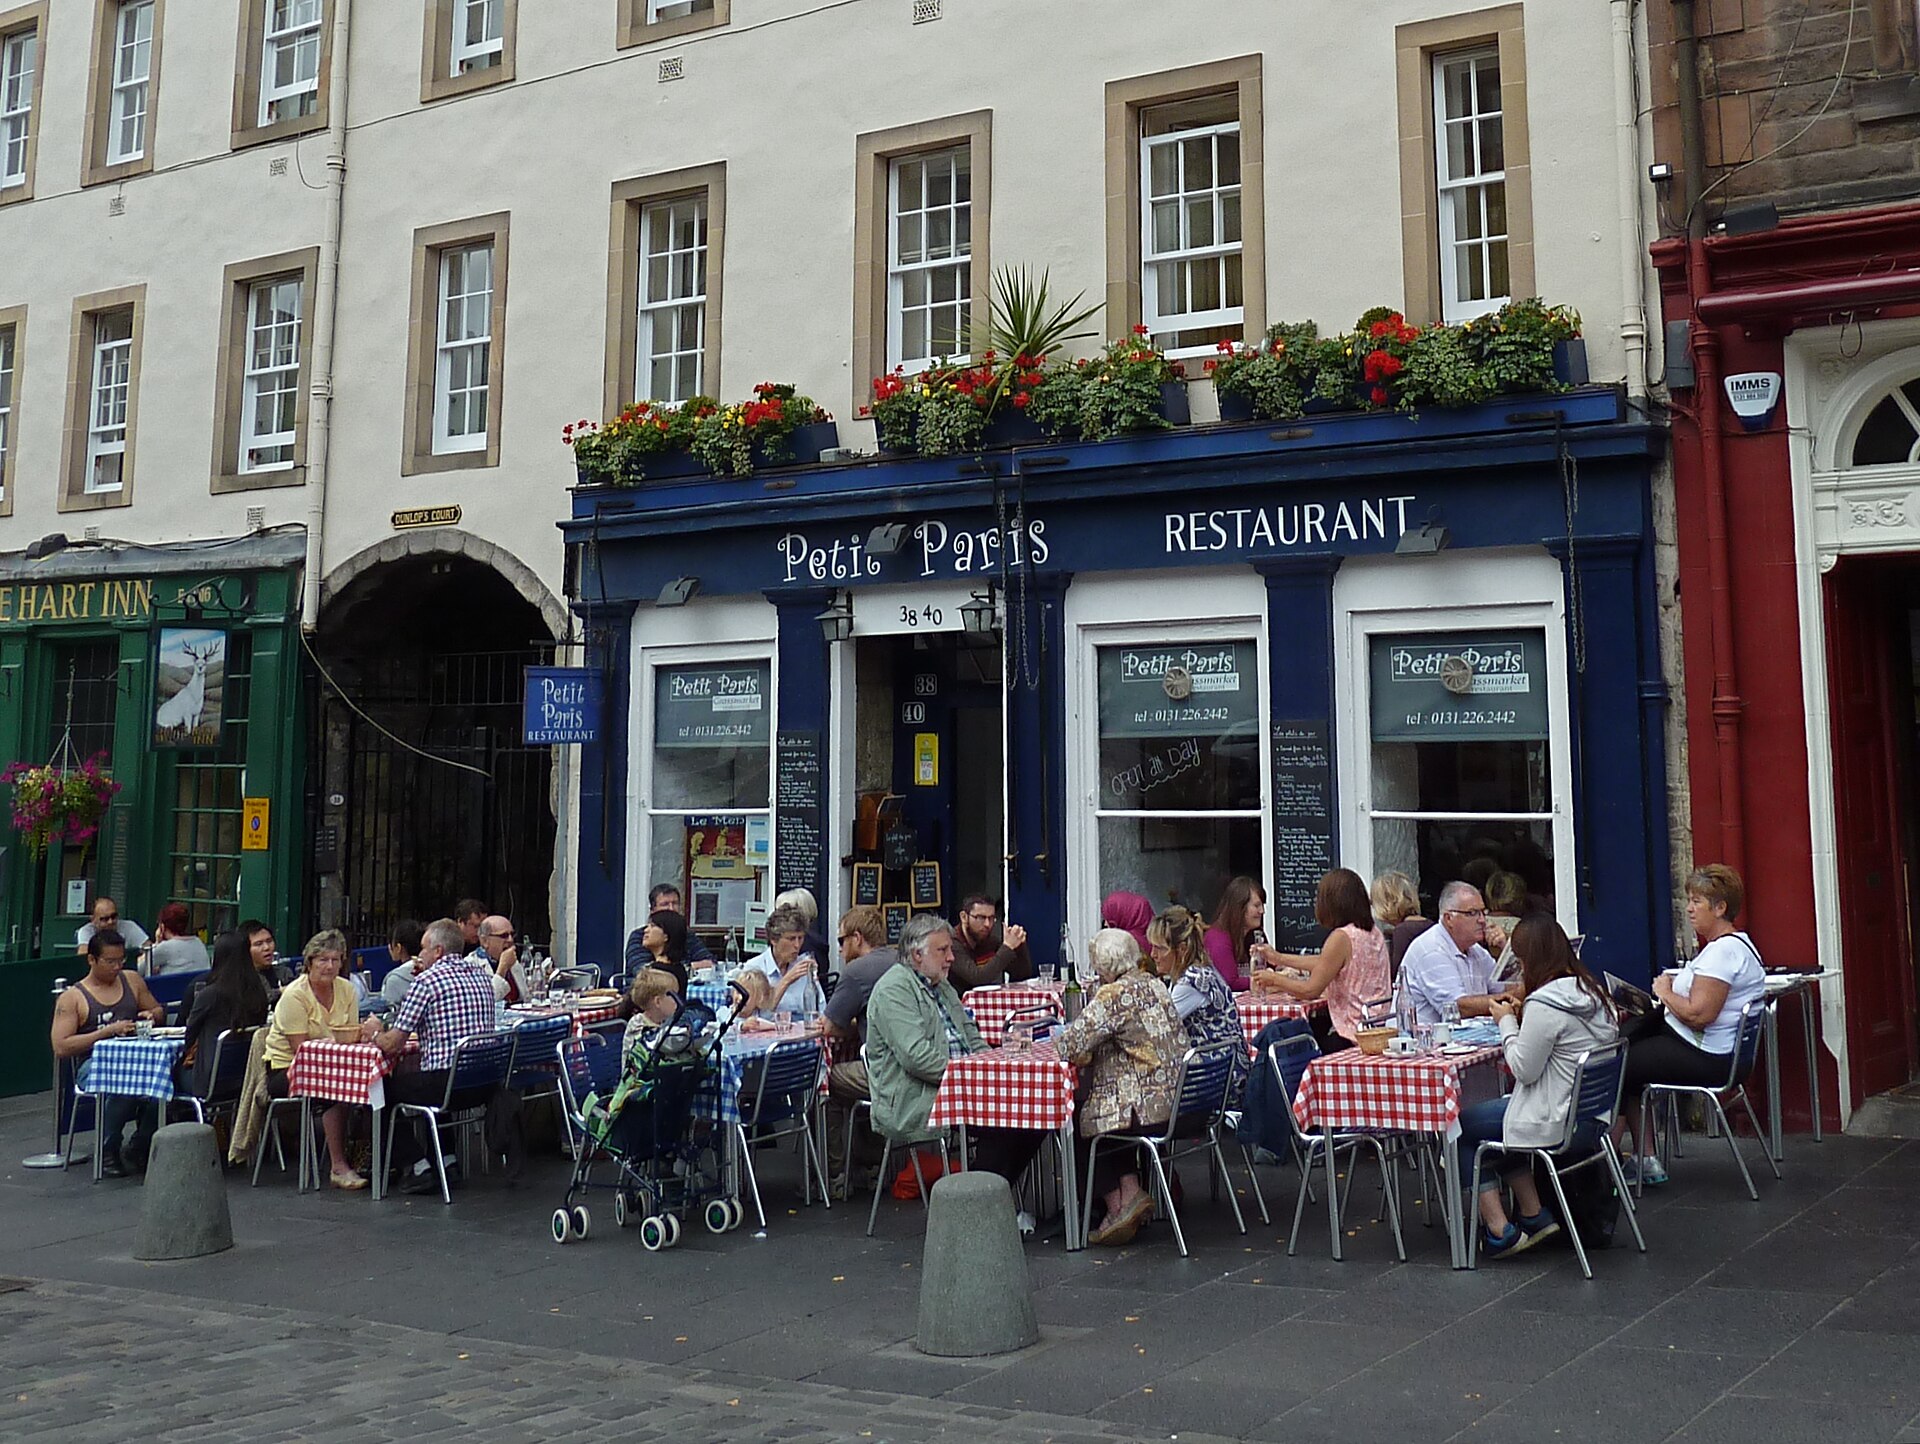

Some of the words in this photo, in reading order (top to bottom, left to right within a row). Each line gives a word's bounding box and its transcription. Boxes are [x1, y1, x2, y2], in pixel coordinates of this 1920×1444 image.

[1731, 378, 1770, 391] IMMS
[431, 508, 456, 521] COURT
[1165, 496, 1416, 552] RESTAURANT
[913, 519, 1050, 577] Paris
[17, 583, 96, 620] HART
[101, 579, 152, 617] INN
[900, 605, 918, 626] 38
[923, 604, 943, 626] 40
[1123, 652, 1174, 676] Petit
[1181, 650, 1234, 673] Paris
[1461, 648, 1522, 673] Paris
[672, 675, 712, 696] Petit
[717, 674, 758, 695] Paris
[917, 676, 934, 693] 38
[1192, 674, 1237, 685] ssmarket
[1473, 674, 1526, 685] ssmarket
[541, 678, 585, 704] Petit
[541, 703, 583, 729] Paris
[904, 704, 922, 721] 40
[1155, 707, 1228, 722] 0131.226.2442
[1431, 711, 1515, 725] 0131.226.2442
[528, 730, 594, 741] RESTAURANT
[1167, 738, 1200, 767] Day
[712, 815, 744, 826] Men
